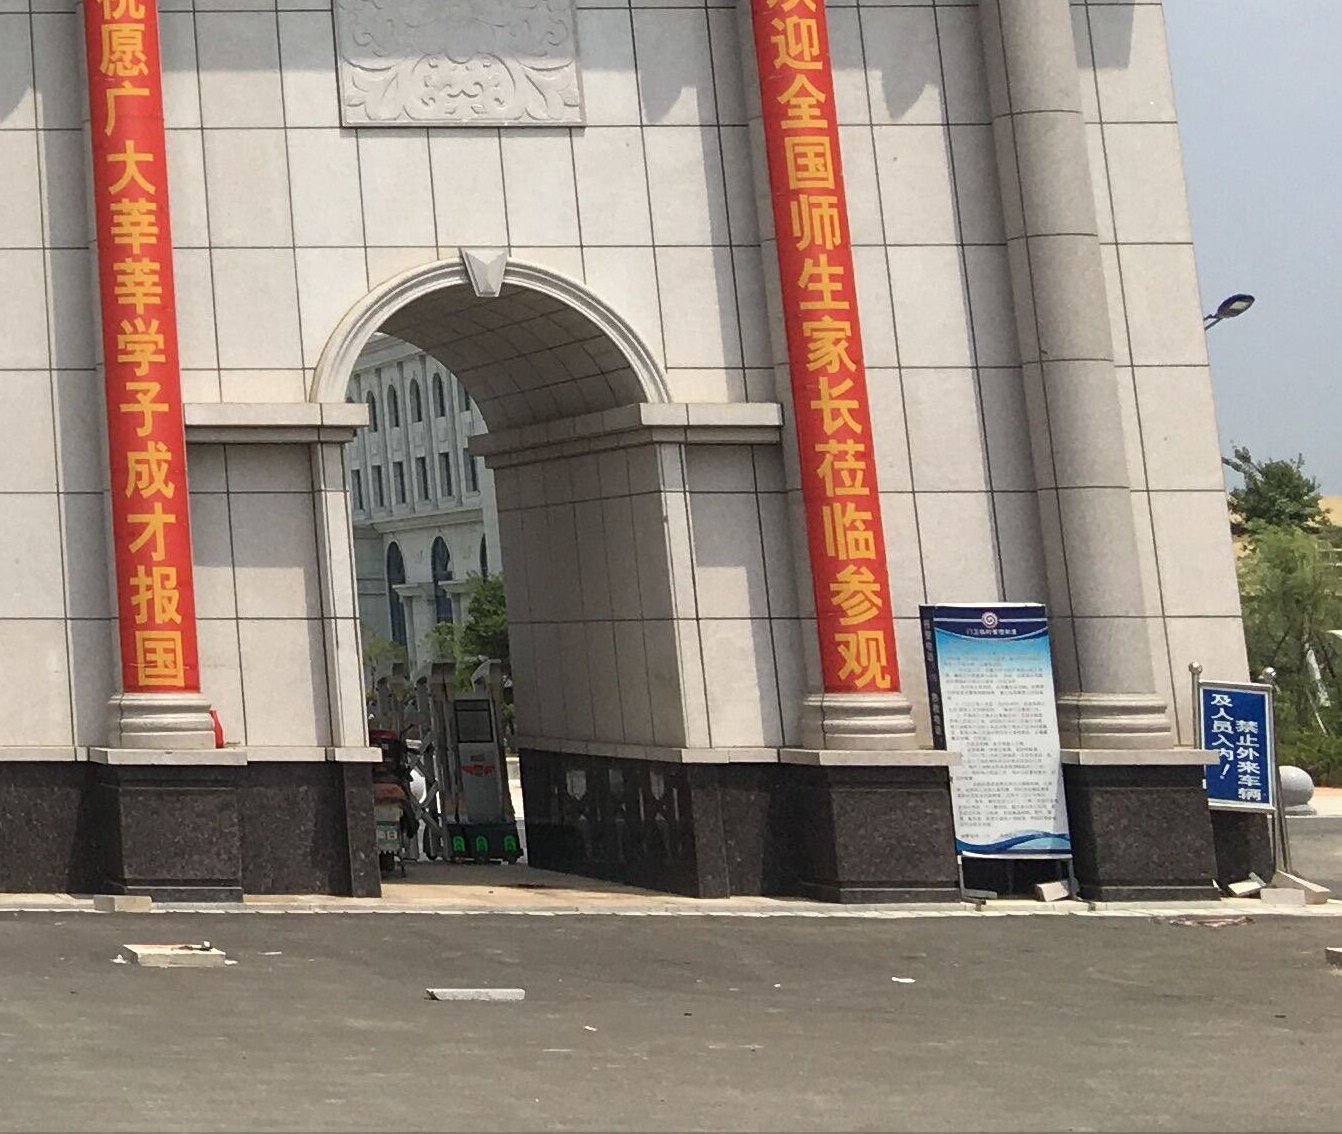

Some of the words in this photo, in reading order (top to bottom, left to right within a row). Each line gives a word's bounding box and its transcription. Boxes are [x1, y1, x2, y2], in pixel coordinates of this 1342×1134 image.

[1235, 719, 1262, 801] 禁止外来车辆
